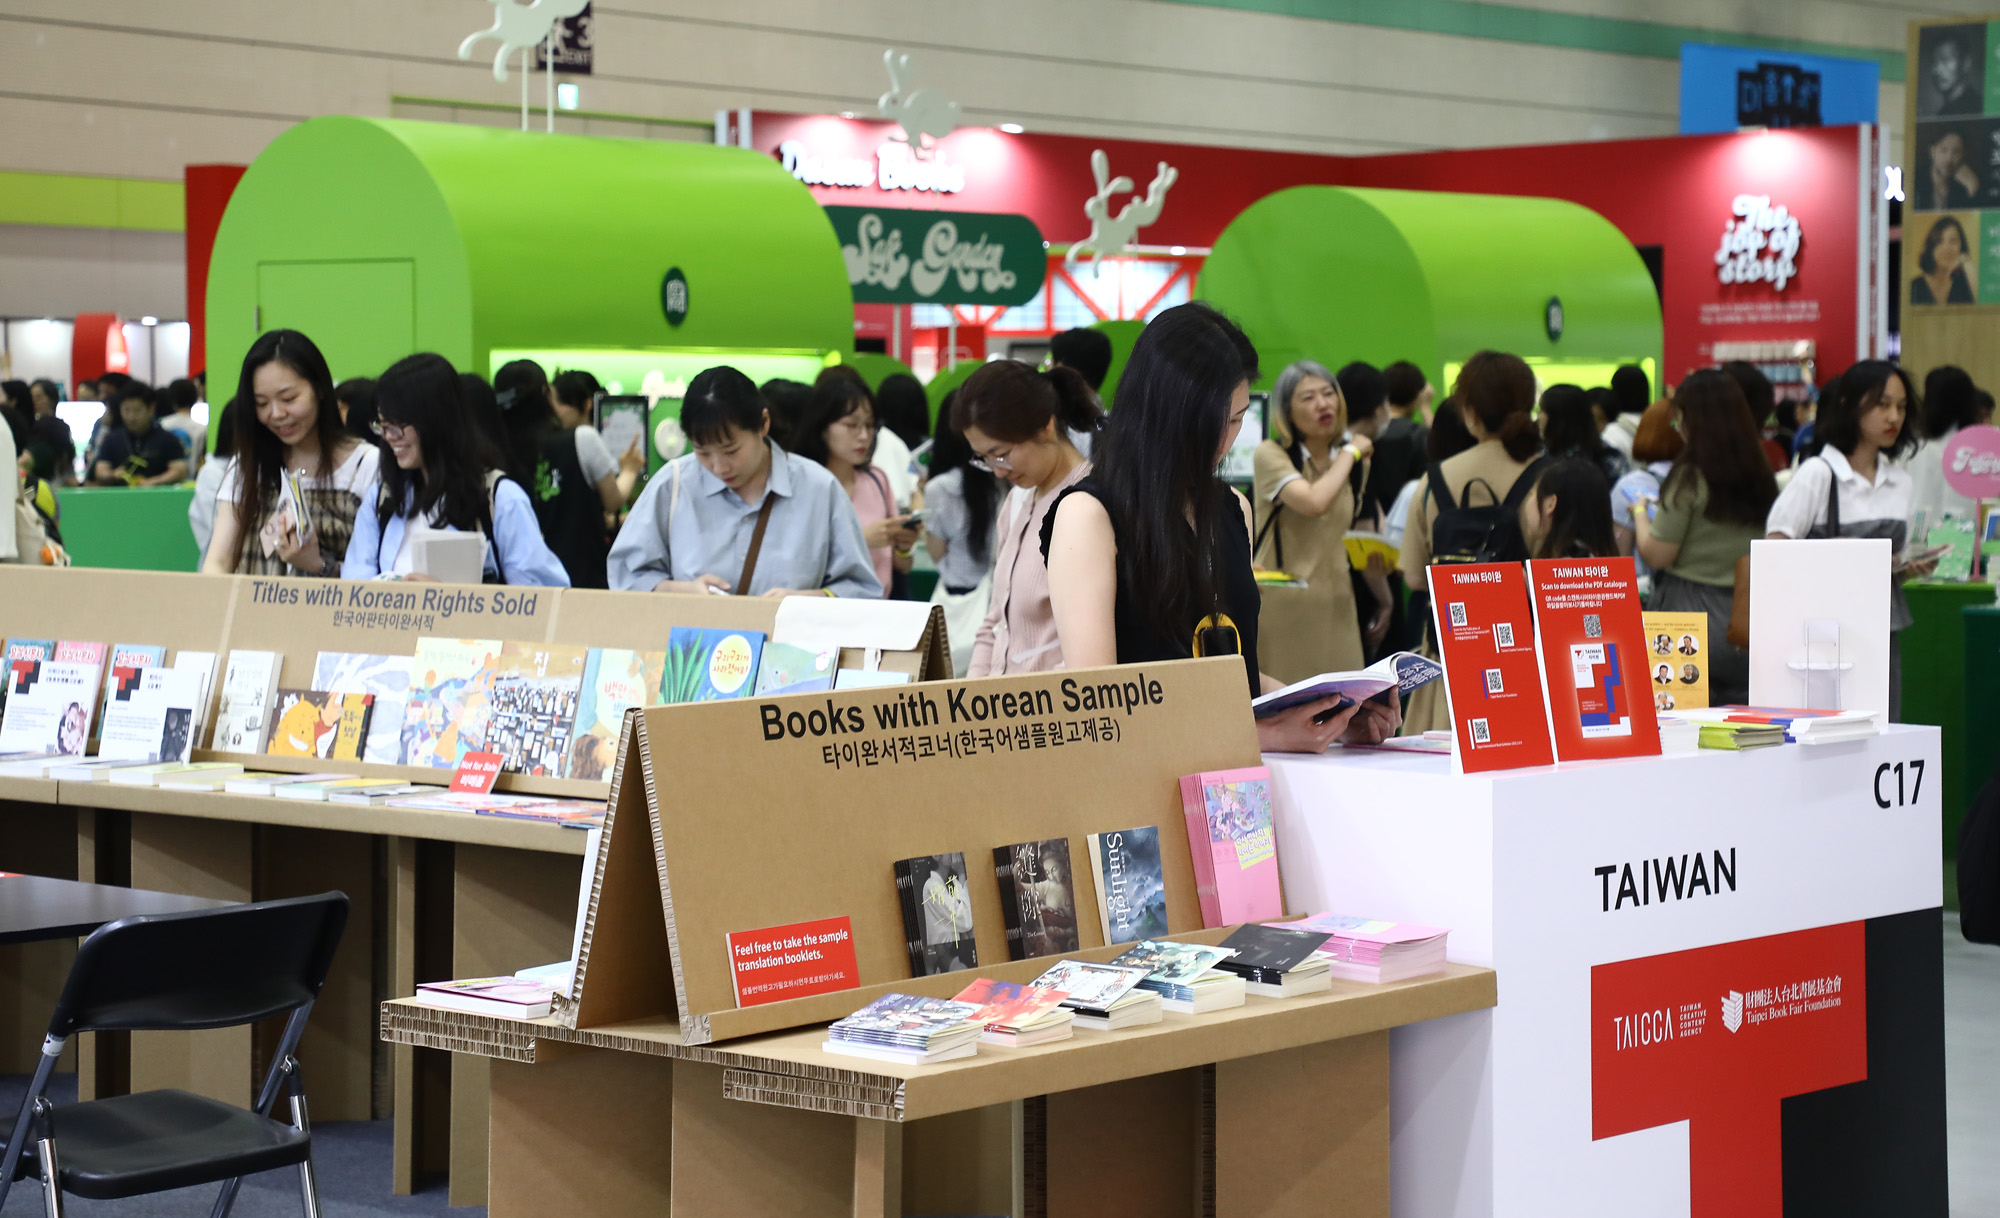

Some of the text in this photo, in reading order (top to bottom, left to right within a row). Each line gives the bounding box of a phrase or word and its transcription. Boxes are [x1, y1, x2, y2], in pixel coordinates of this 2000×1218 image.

[1452, 570, 1502, 584] TAIWAN 타이완
[1541, 582, 1554, 590] Scan
[1553, 582, 1559, 590] to
[1559, 581, 1584, 590] download
[1584, 581, 1593, 589] the
[1603, 580, 1628, 589] catalogue
[1552, 565, 1609, 578] TAIWAN 타이완
[252, 581, 538, 618] Titles with Korean Rights Sold
[333, 610, 435, 632] 한국어판타이완서적
[534, 651, 550, 677] 집
[760, 673, 1164, 741] Books with Korean Sample
[822, 717, 1122, 770] 타이완서적코너(한국어샘플원고제공)
[1873, 759, 1925, 809] C17
[1106, 832, 1131, 931] Sunlight
[1594, 847, 1737, 912] TAIWAN
[735, 928, 849, 957] Feel free to take the sample
[737, 949, 824, 972] translation booklets.
[1745, 974, 1842, 1009] 財團法人台北書展基金會
[1680, 1002, 1702, 1012] TAIWAN
[1680, 1009, 1707, 1021] CREATIVE
[1746, 995, 1842, 1026] Taipei Book Fair Foundation
[1613, 1007, 1674, 1051] TAICCA
[1680, 1018, 1706, 1029] CONTENT
[1680, 1027, 1702, 1038] AGENCY
